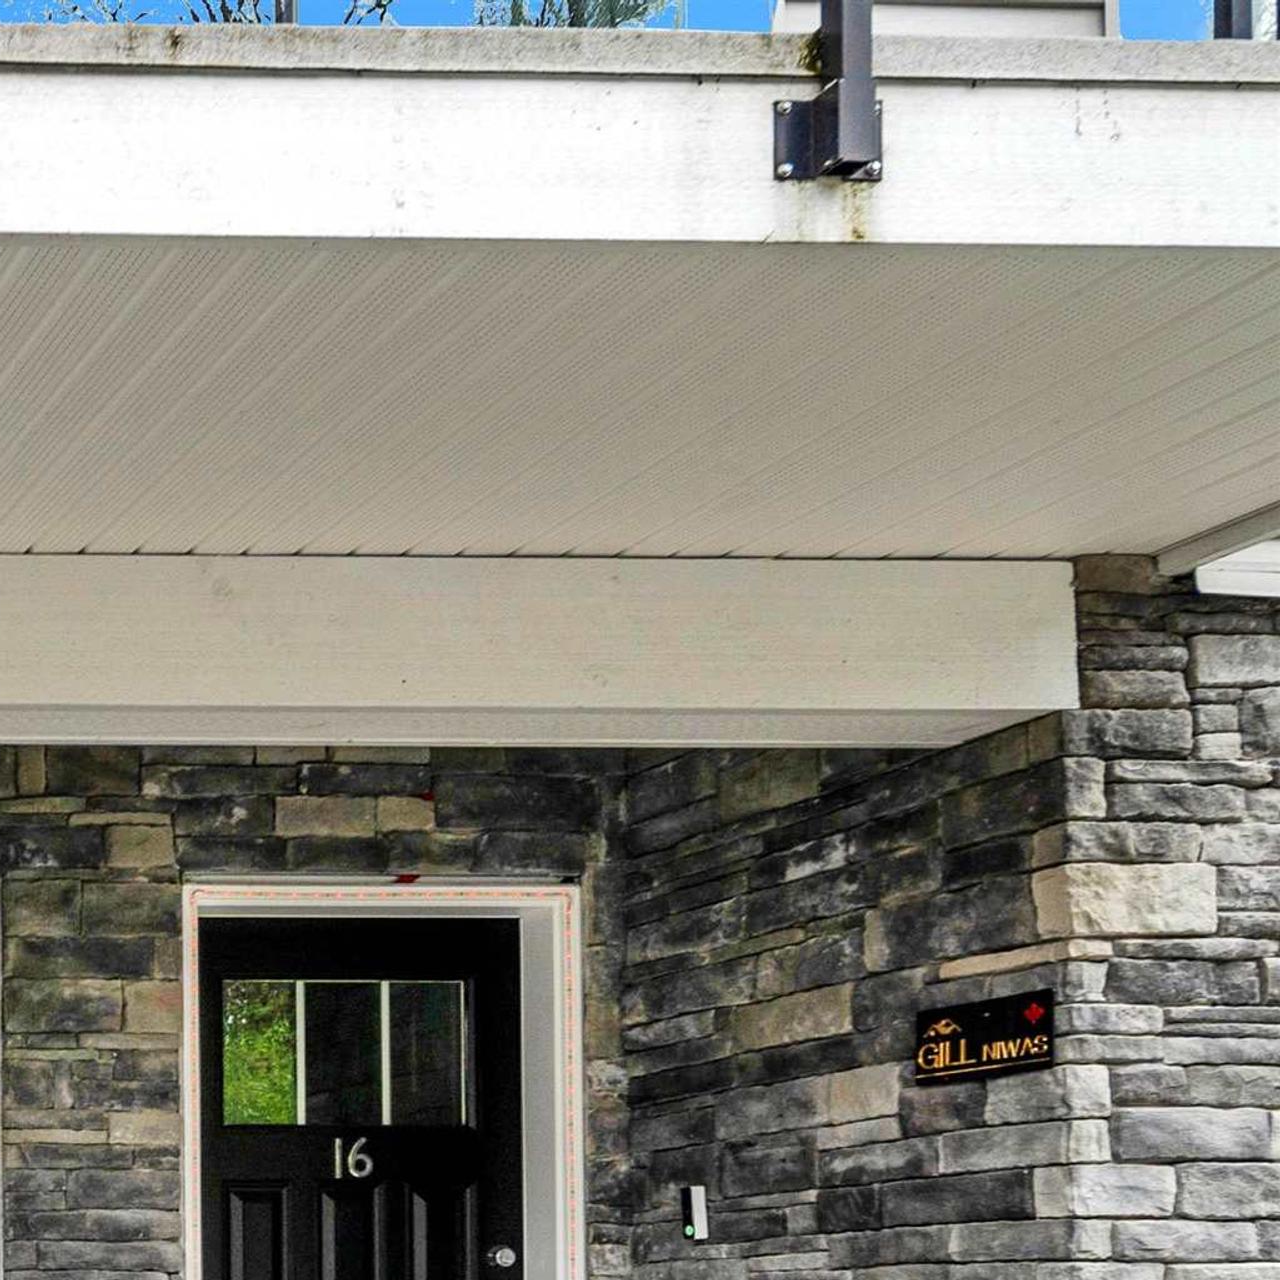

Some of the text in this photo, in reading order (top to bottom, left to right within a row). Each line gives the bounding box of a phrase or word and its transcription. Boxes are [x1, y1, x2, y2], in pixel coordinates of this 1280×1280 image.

[917, 1034, 1048, 1069] GILL NIWAS
[334, 1137, 373, 1179] 16
